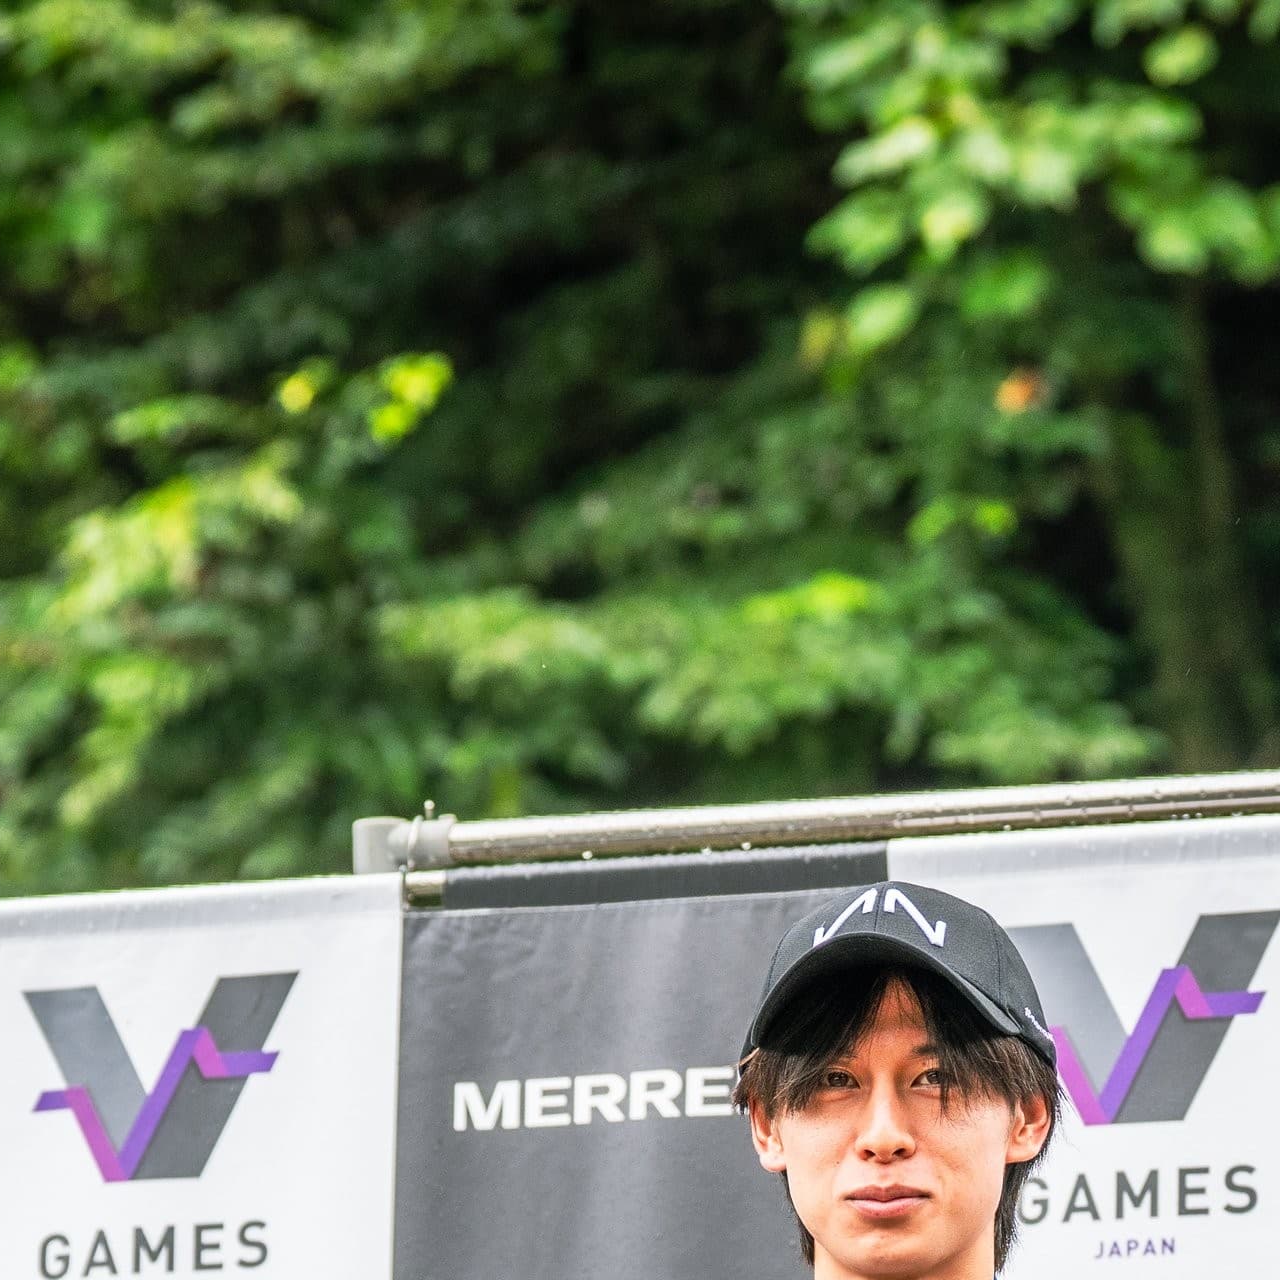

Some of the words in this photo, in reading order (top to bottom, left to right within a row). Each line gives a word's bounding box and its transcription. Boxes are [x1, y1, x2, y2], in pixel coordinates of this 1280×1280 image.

[452, 1066, 744, 1132] MERRE
[1018, 1164, 1259, 1225] GAMES
[38, 1220, 269, 1280] GAMES
[1094, 1237, 1177, 1259] JAPAN
